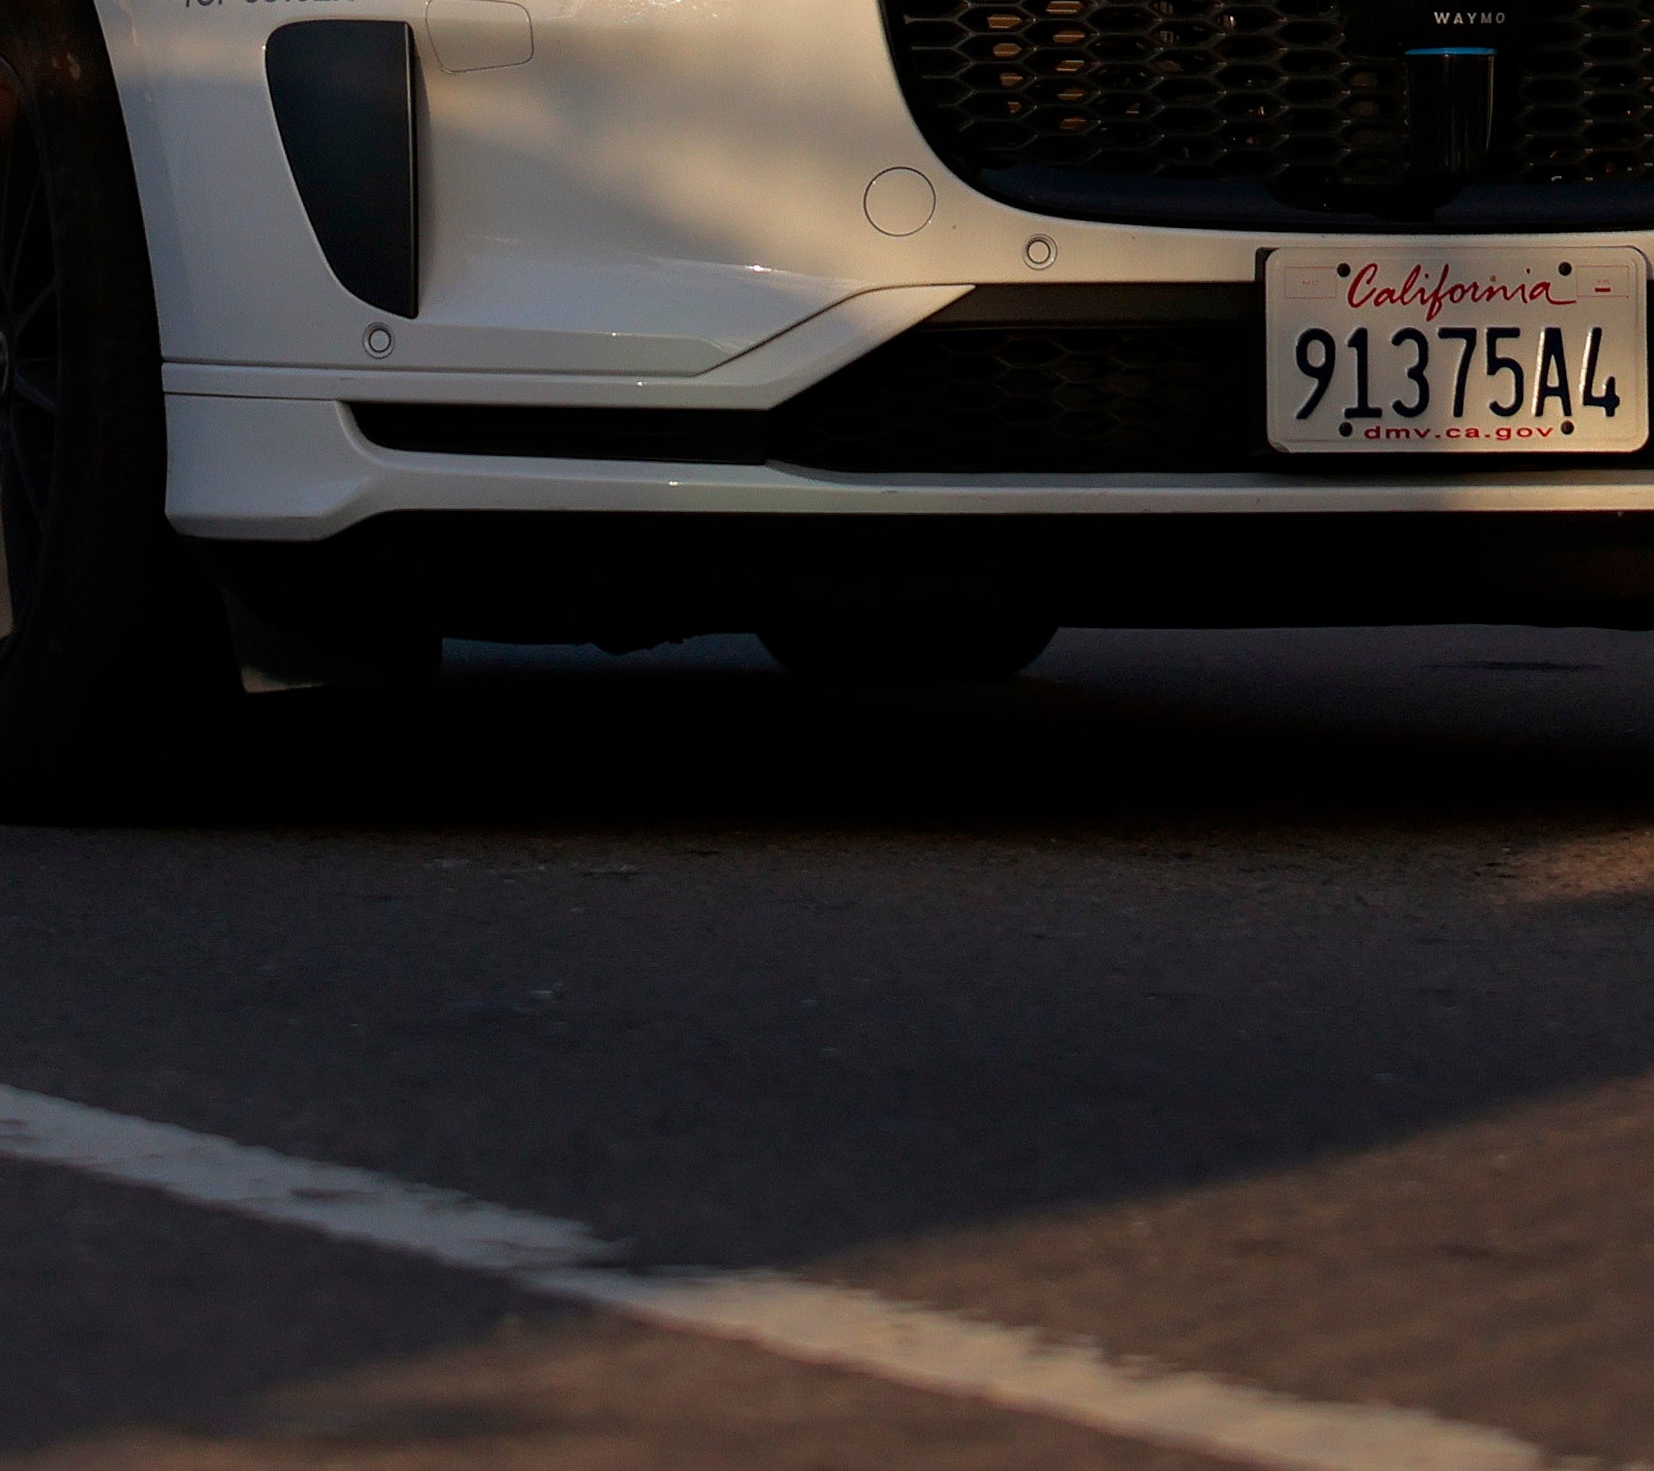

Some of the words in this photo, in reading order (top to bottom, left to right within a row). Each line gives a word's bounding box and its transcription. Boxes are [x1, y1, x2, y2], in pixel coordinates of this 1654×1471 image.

[1433, 11, 1507, 26] WAYMO
[1347, 262, 1578, 321] California
[1294, 326, 1621, 420] 91375A4
[1363, 425, 1555, 441] dmv.ca.gov
